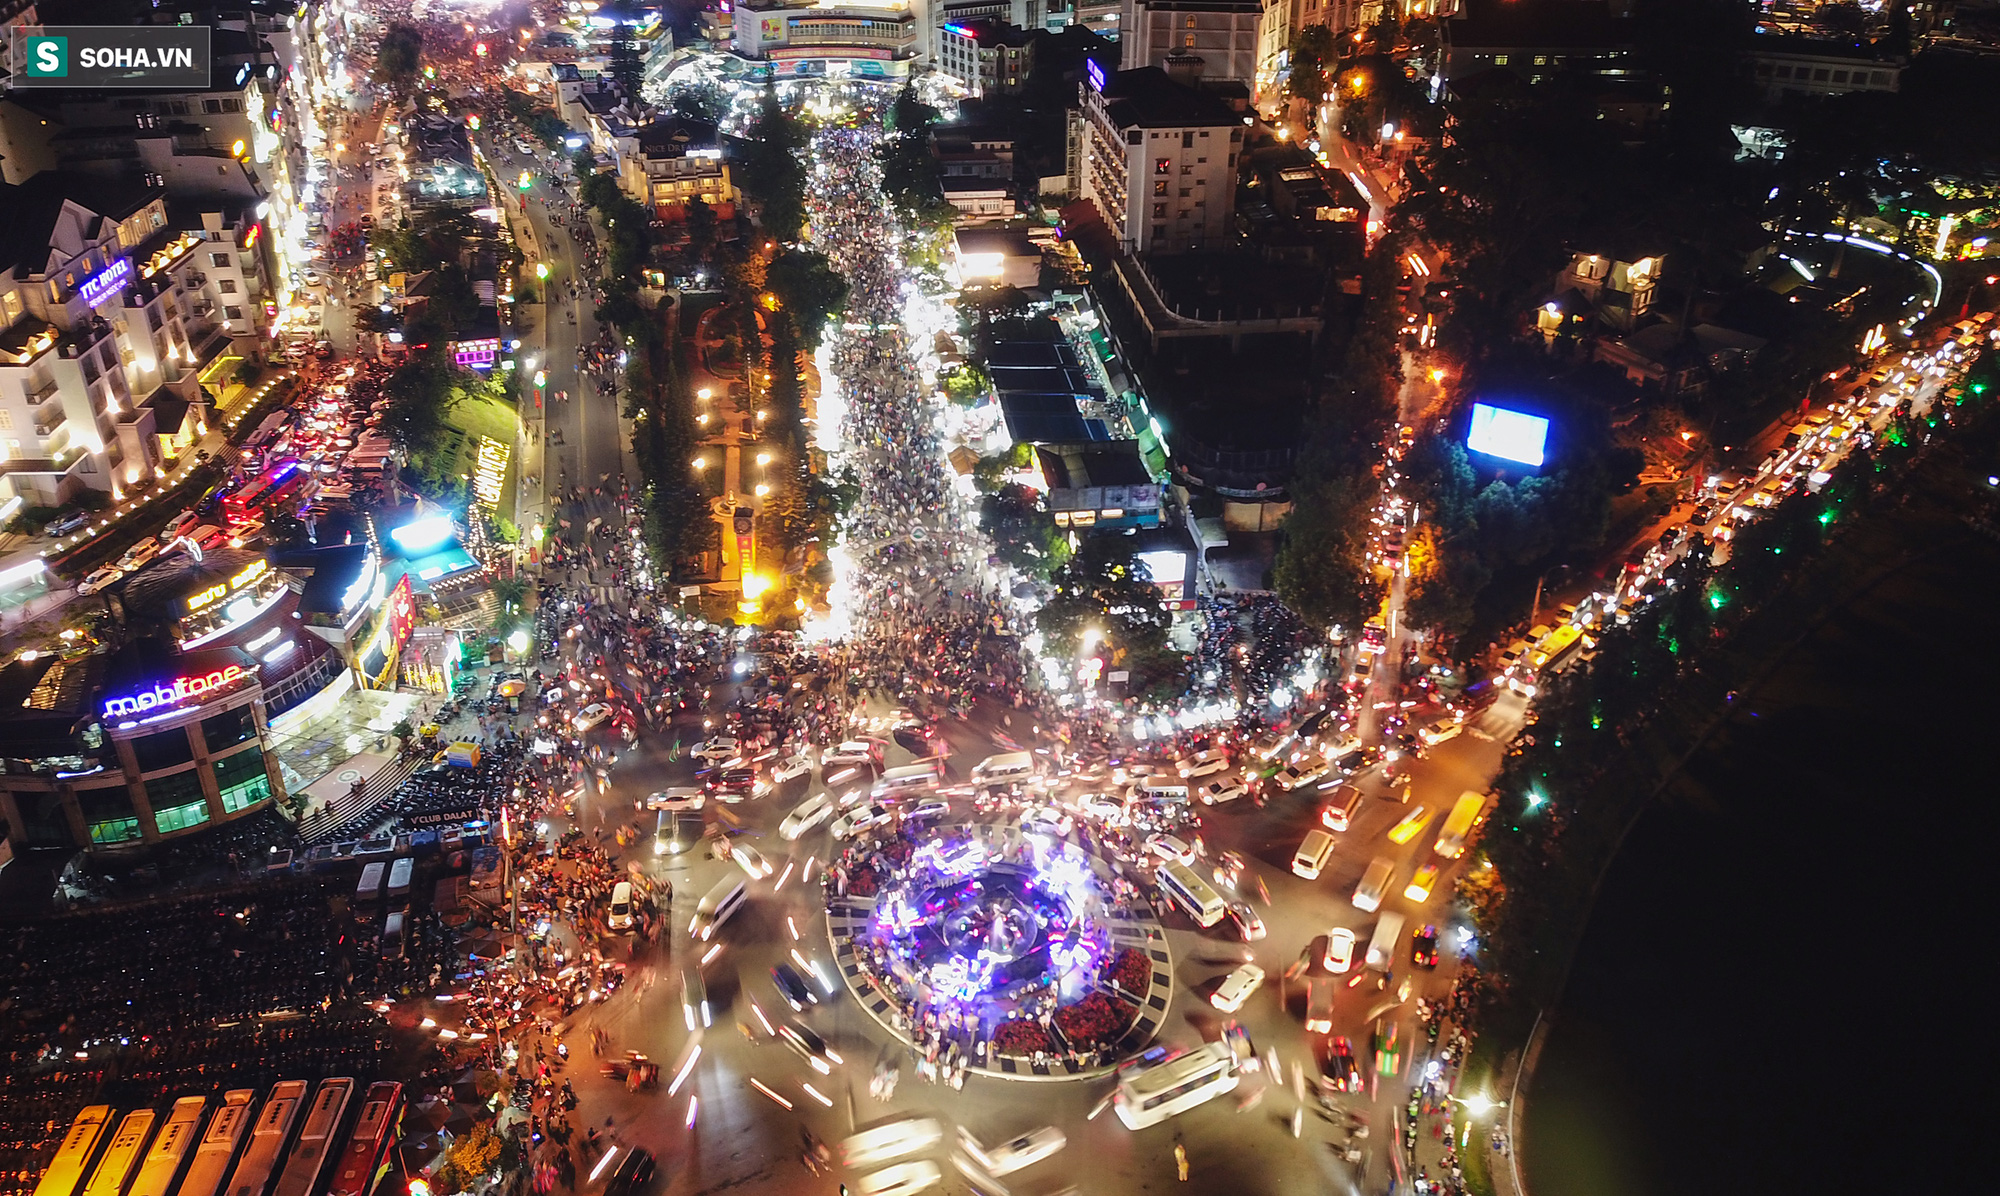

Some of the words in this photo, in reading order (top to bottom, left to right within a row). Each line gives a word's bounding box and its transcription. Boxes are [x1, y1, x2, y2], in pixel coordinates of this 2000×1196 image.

[644, 144, 666, 153] NICE
[667, 143, 700, 152] DREAM
[80, 278, 100, 299] TTC
[98, 259, 129, 286] HOTEL
[187, 584, 227, 610] BƯU
[104, 664, 241, 716] mobifone
[443, 810, 473, 820] DALAT
